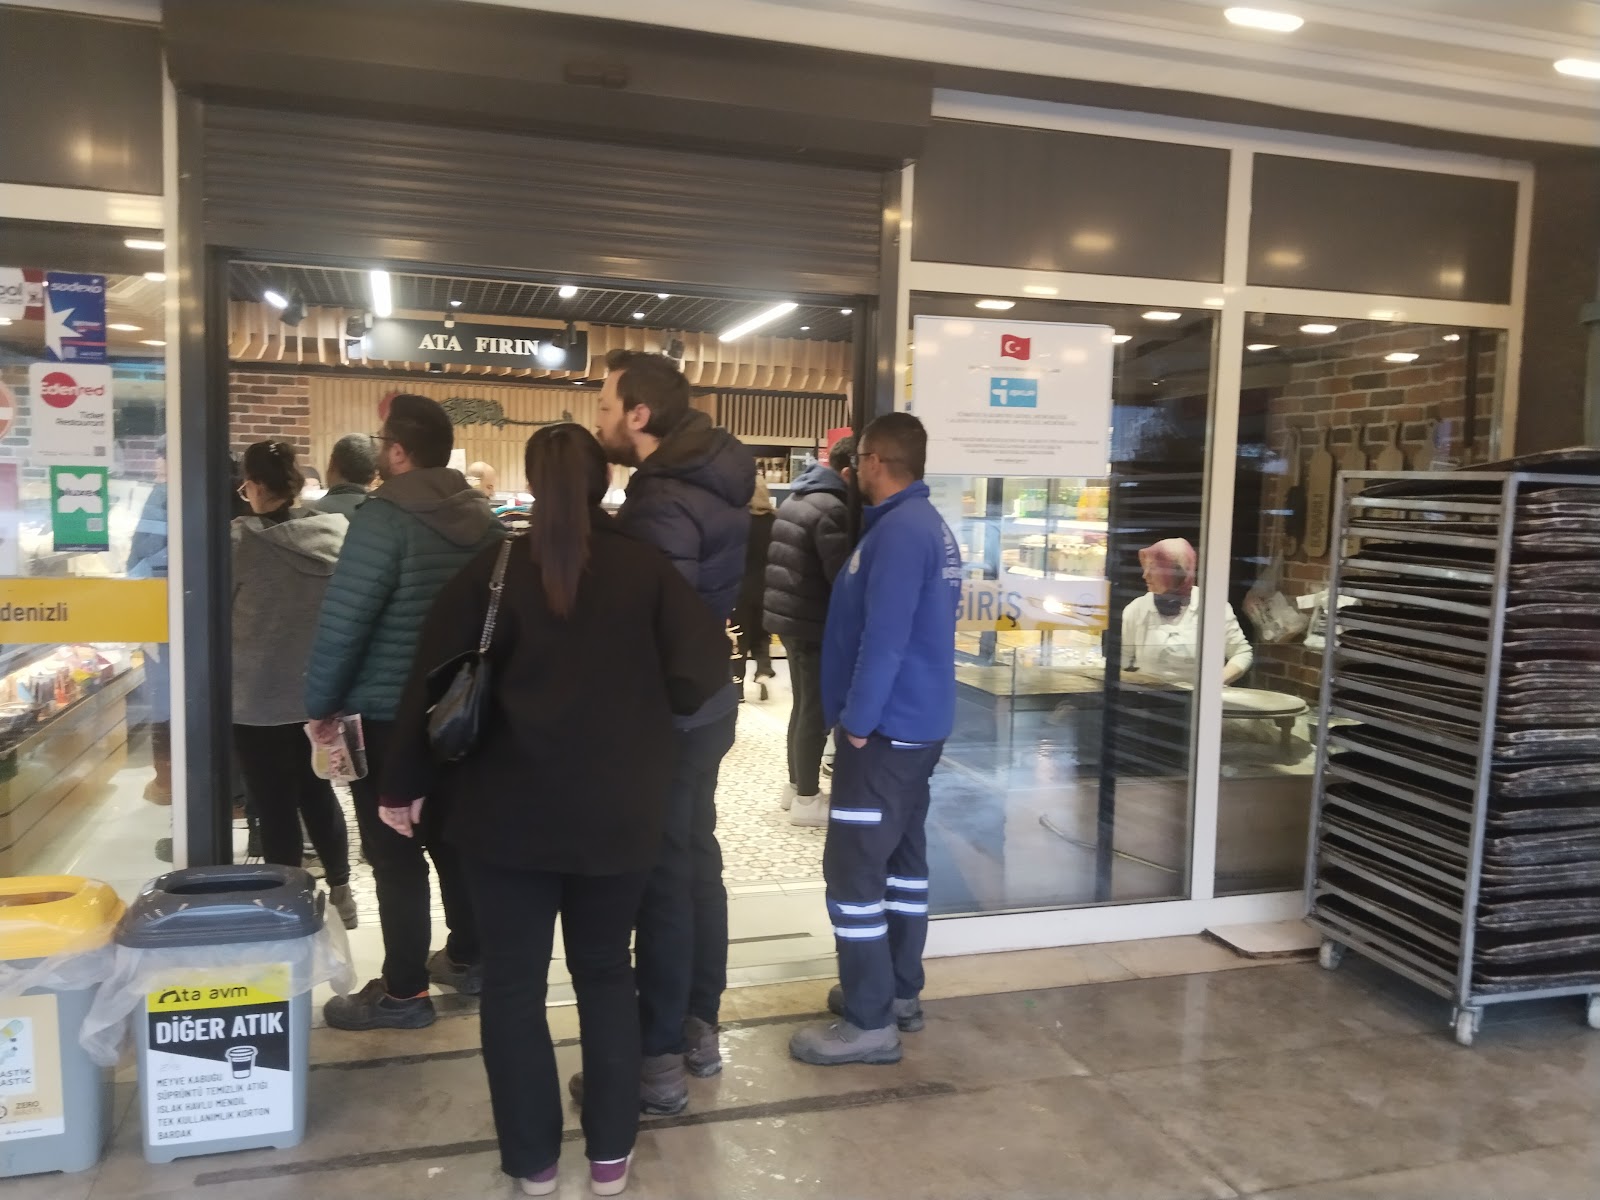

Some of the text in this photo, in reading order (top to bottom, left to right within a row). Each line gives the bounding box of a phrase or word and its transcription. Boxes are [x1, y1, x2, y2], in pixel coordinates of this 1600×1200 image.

[50, 282, 103, 294] sodexo
[418, 333, 539, 356] ATA FIRIN
[41, 382, 105, 396] Edenred
[209, 986, 248, 999] avm
[156, 1011, 284, 1044] DİĞER ATIK
